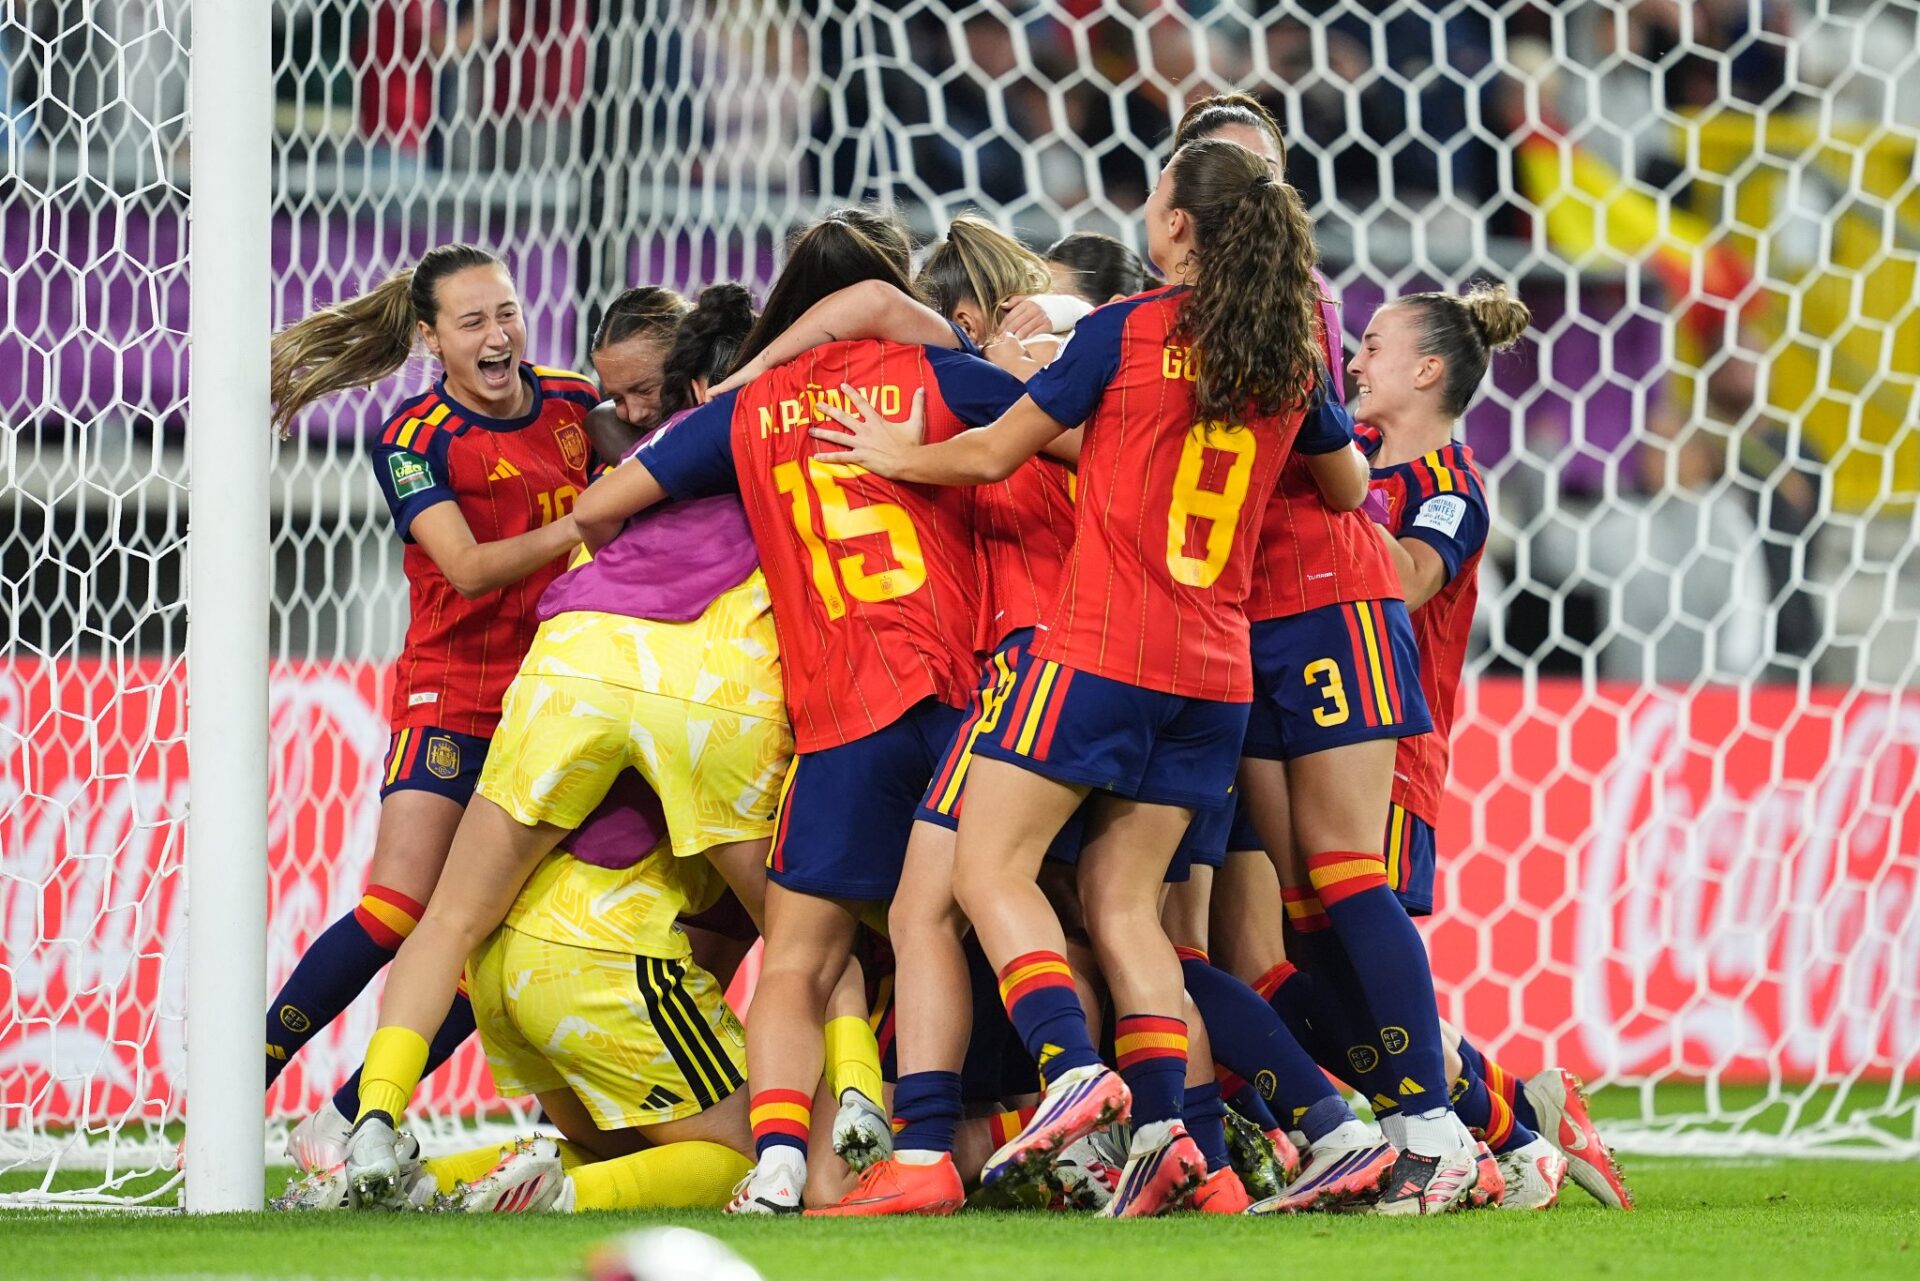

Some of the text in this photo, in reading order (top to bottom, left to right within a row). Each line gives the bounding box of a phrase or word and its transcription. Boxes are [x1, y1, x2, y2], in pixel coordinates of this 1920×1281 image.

[771, 456, 928, 621] 15
[1165, 419, 1257, 589] 8
[1428, 504, 1456, 518] UNITES
[1303, 657, 1350, 728] 3
